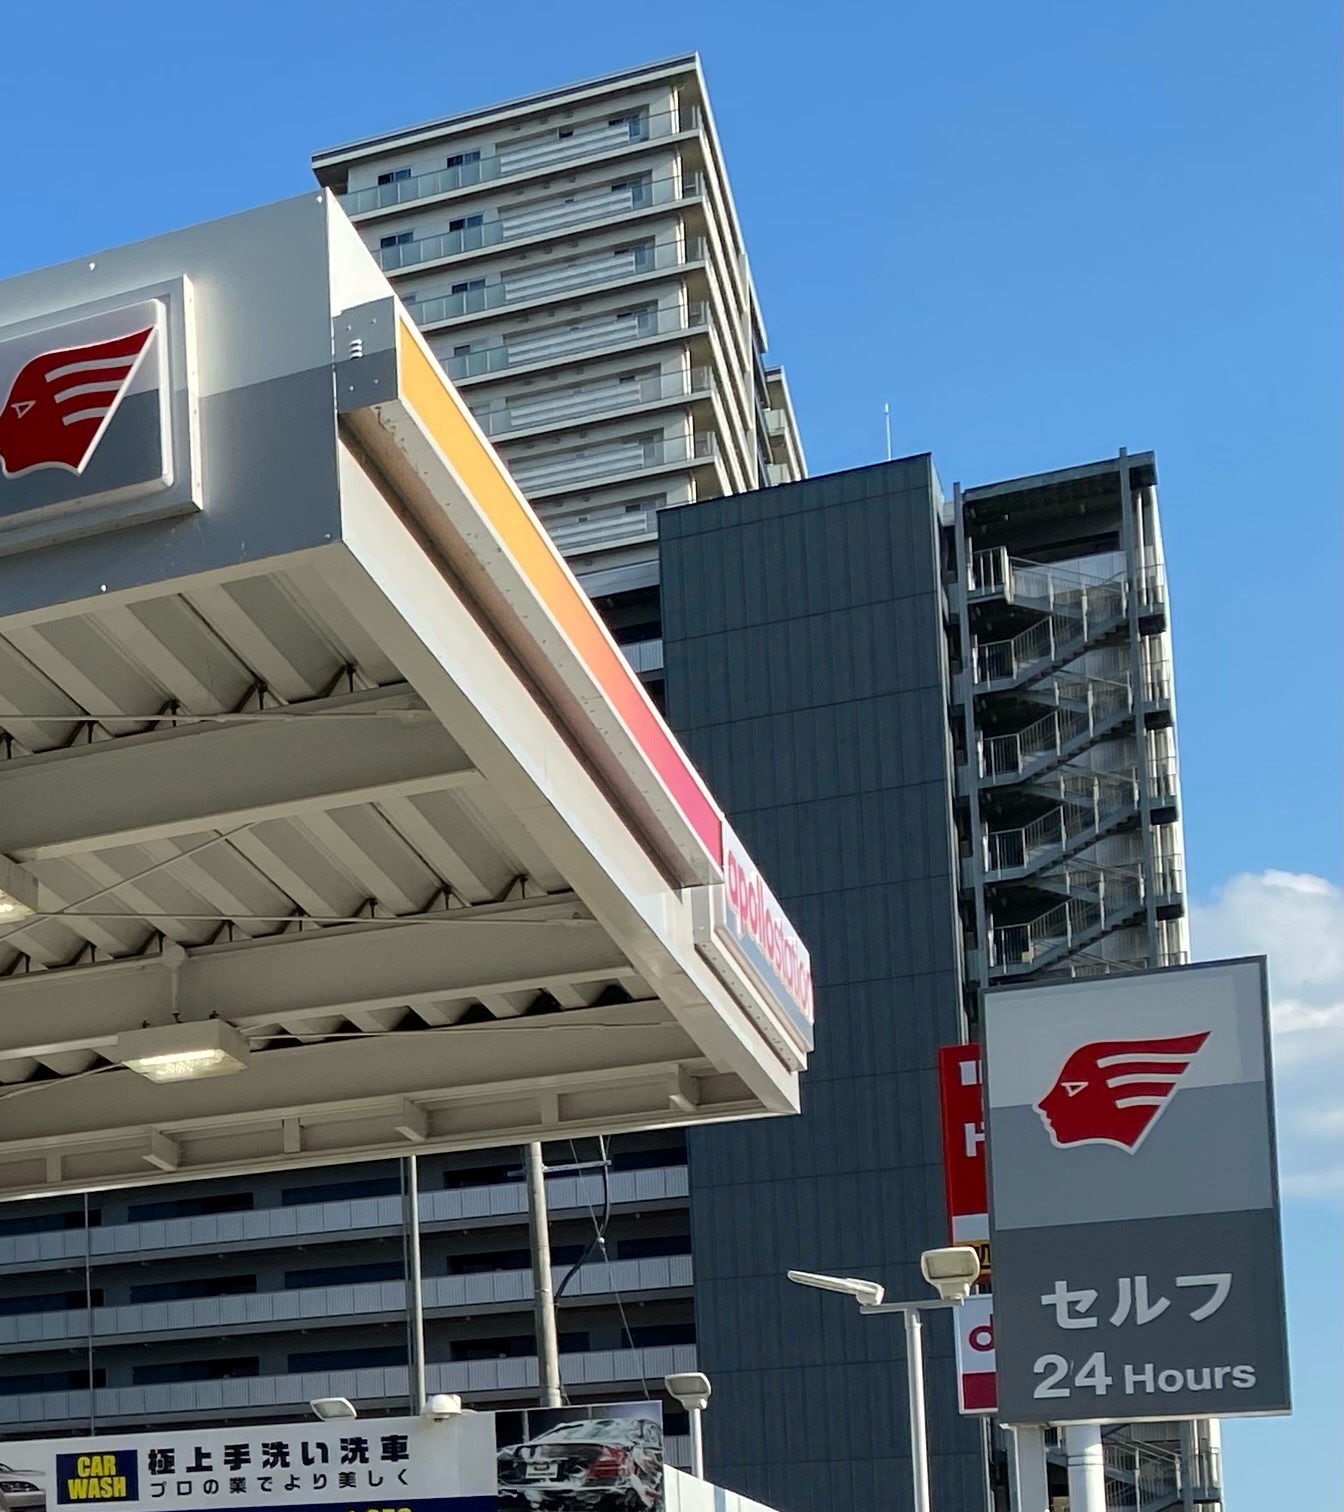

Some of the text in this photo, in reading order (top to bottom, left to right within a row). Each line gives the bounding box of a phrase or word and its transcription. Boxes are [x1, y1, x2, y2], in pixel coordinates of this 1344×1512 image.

[1041, 1273, 1232, 1329] セルフ
[1033, 1352, 1257, 1399] 24 Hours
[77, 1455, 117, 1477] CAR
[148, 1434, 410, 1477] 極上手洗い洗車
[68, 1476, 127, 1500] WASH
[150, 1468, 410, 1499] プロの業でより美しく
